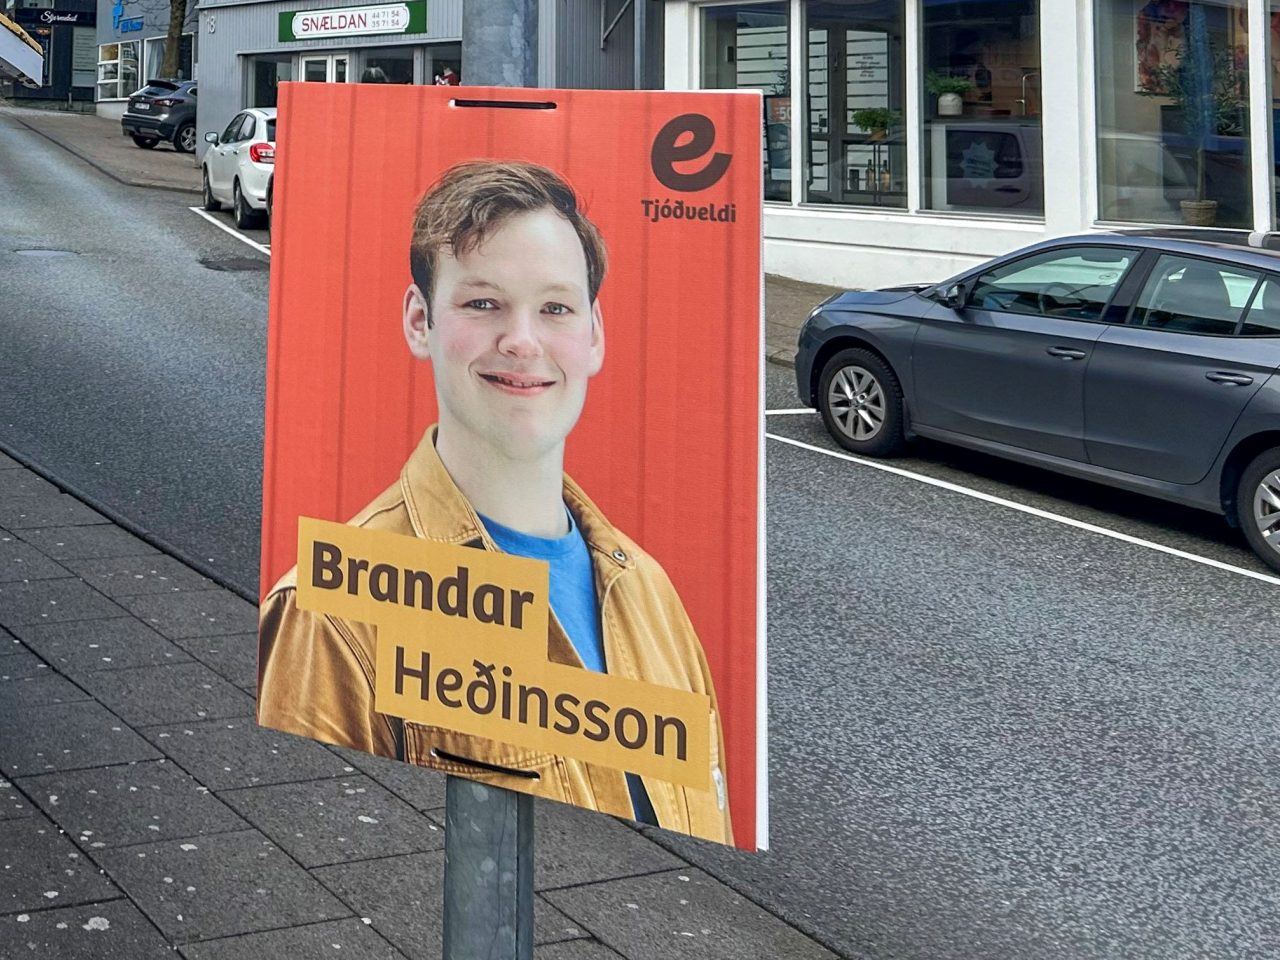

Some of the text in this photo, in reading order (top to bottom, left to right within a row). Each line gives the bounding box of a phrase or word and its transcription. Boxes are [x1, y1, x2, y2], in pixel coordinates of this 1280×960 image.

[206, 16, 216, 34] 18
[301, 12, 368, 32] SNÆLDAN
[641, 198, 736, 222] Tjóðveldi
[311, 540, 534, 629] Brandar
[394, 645, 688, 761] Heðinsson
